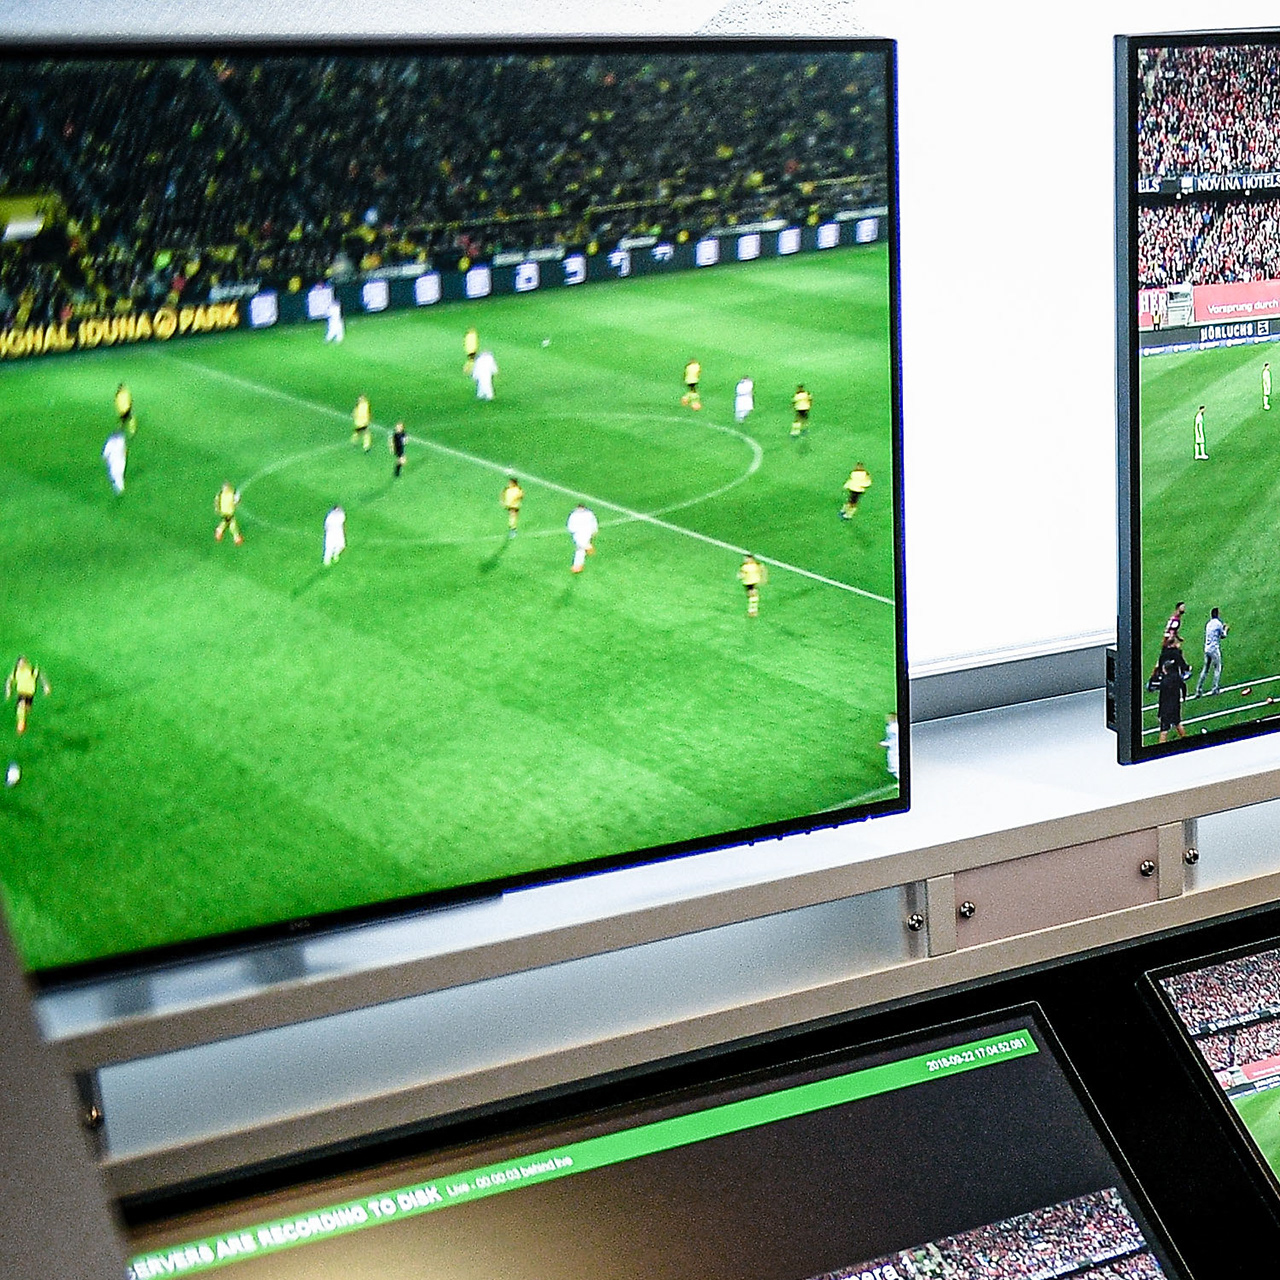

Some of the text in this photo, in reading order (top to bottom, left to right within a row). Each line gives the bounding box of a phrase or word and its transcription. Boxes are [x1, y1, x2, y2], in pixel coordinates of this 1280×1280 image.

[1197, 178, 1240, 192] NOVINA
[1207, 300, 1254, 316] Vorsprung
[1254, 297, 1278, 310] durch
[178, 302, 240, 336] PARK
[216, 1230, 257, 1262] ARE
[258, 1204, 367, 1253] RECORDING
[368, 1198, 396, 1220] TO
[397, 1185, 443, 1214] DISK
[902, 1256, 916, 1276] 1
